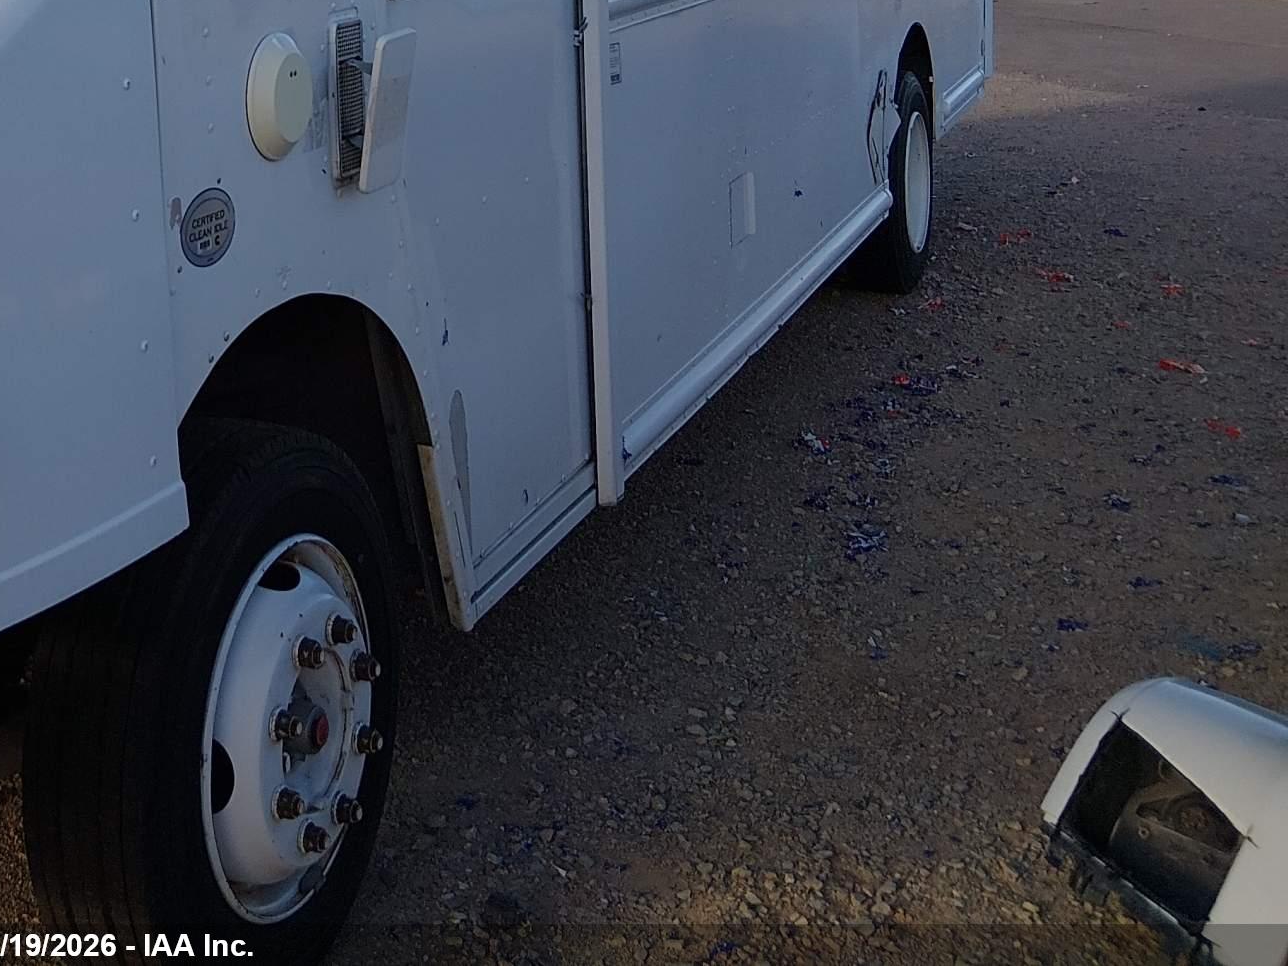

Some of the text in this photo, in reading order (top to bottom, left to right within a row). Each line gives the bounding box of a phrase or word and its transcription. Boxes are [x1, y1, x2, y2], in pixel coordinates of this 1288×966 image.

[192, 209, 225, 229] CERTIFIED
[189, 219, 229, 242] CLEAN IDLE
